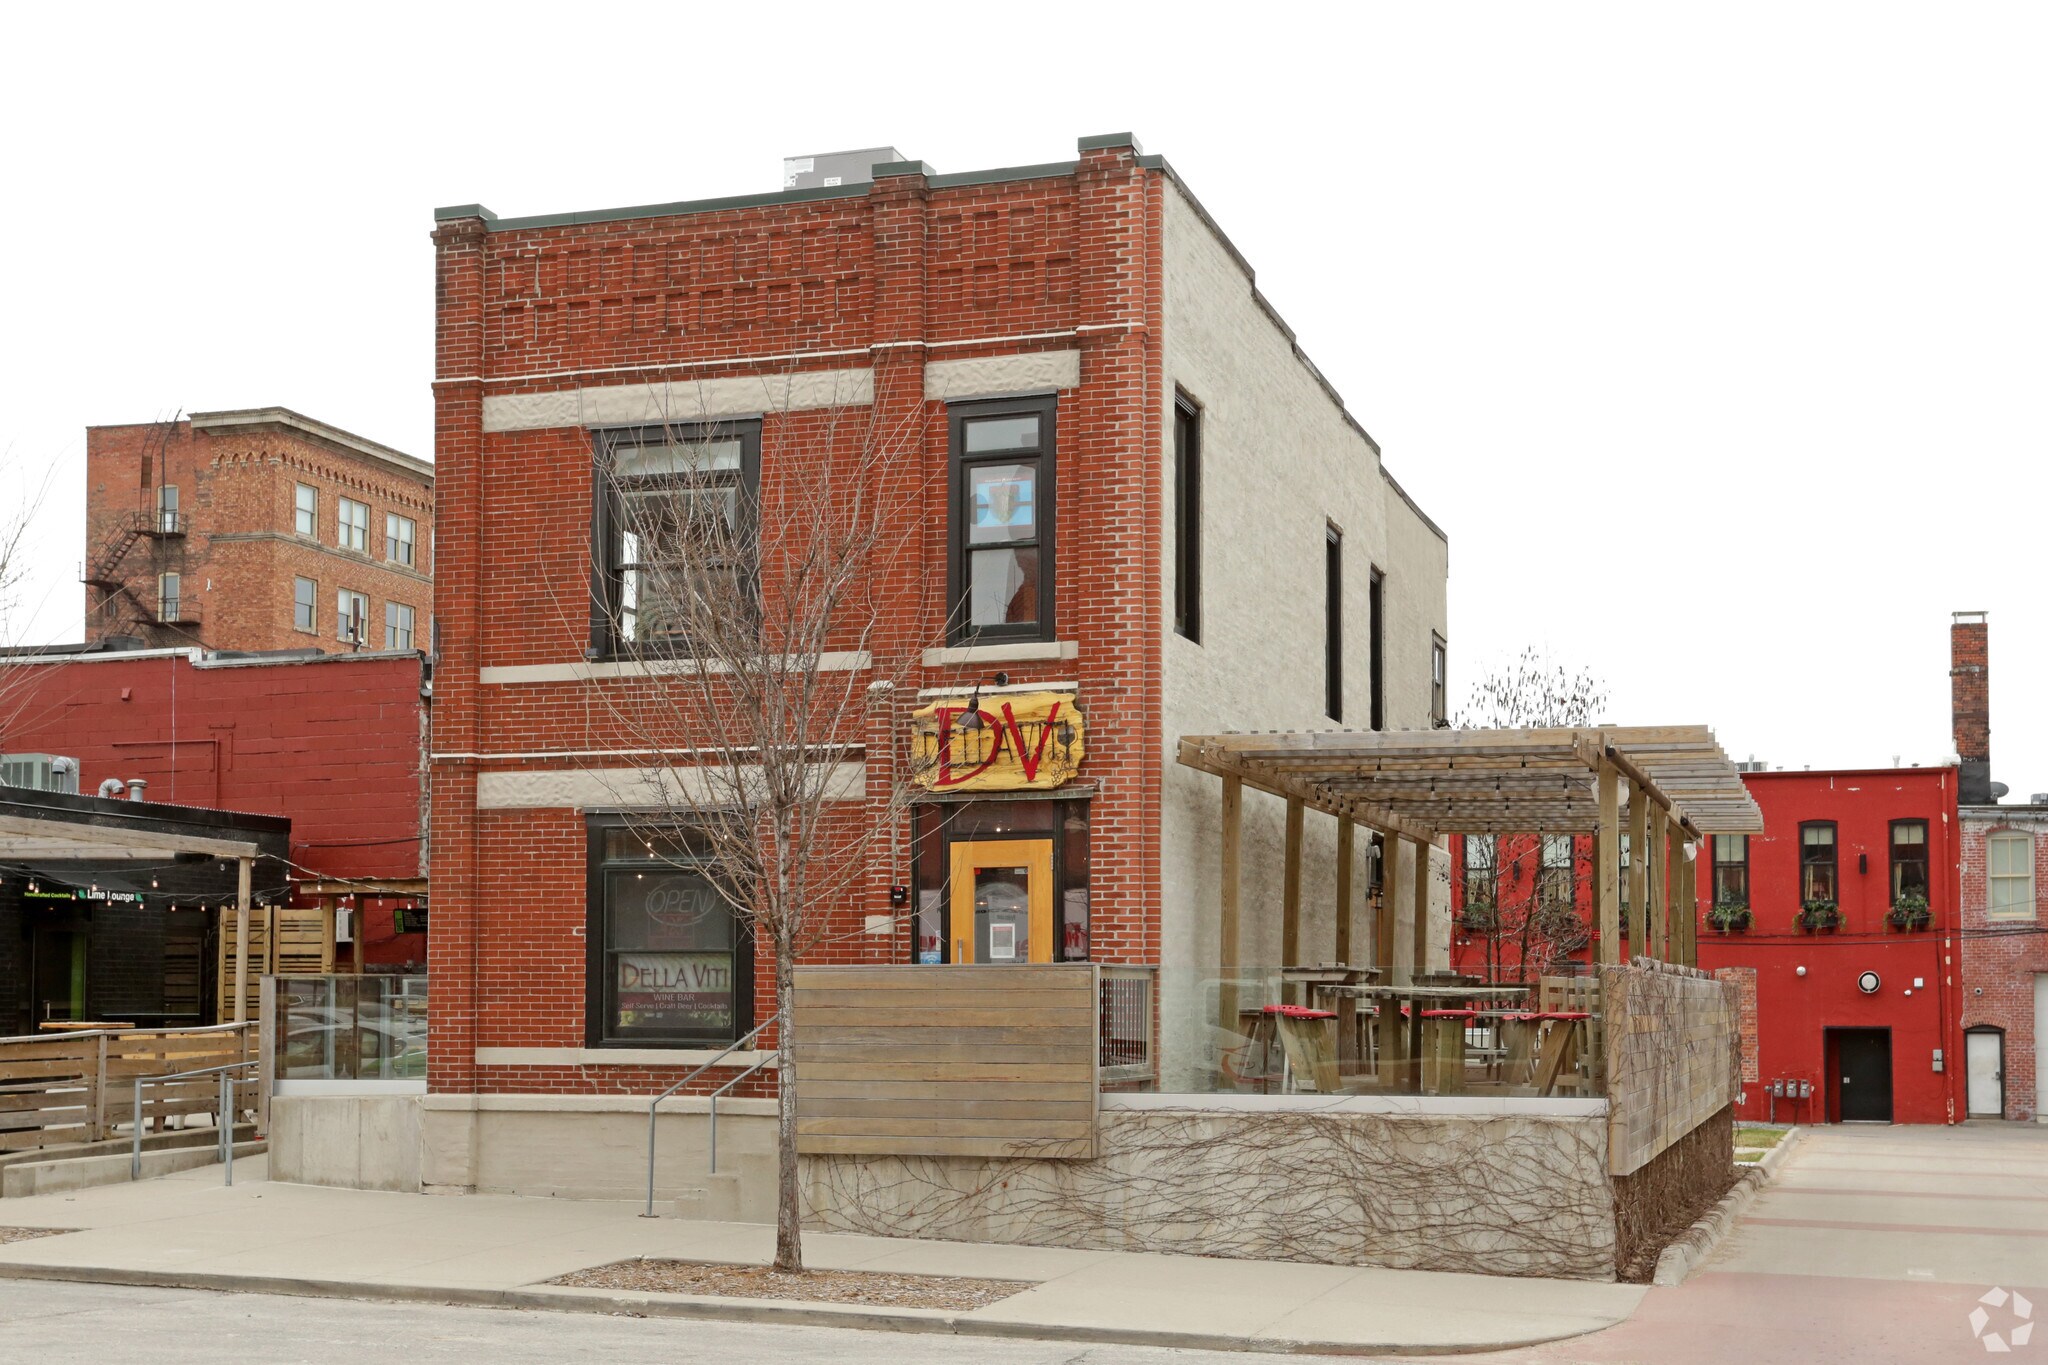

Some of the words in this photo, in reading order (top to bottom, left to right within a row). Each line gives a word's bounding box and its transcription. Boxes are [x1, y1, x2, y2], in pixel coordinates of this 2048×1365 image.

[934, 701, 1061, 786] DV
[87, 889, 105, 900] Lime
[107, 890, 135, 902] Lounge
[649, 889, 710, 913] OPEN
[653, 993, 676, 1001] WINE
[677, 993, 695, 1001] BAR
[698, 1002, 728, 1010] Cocktails
